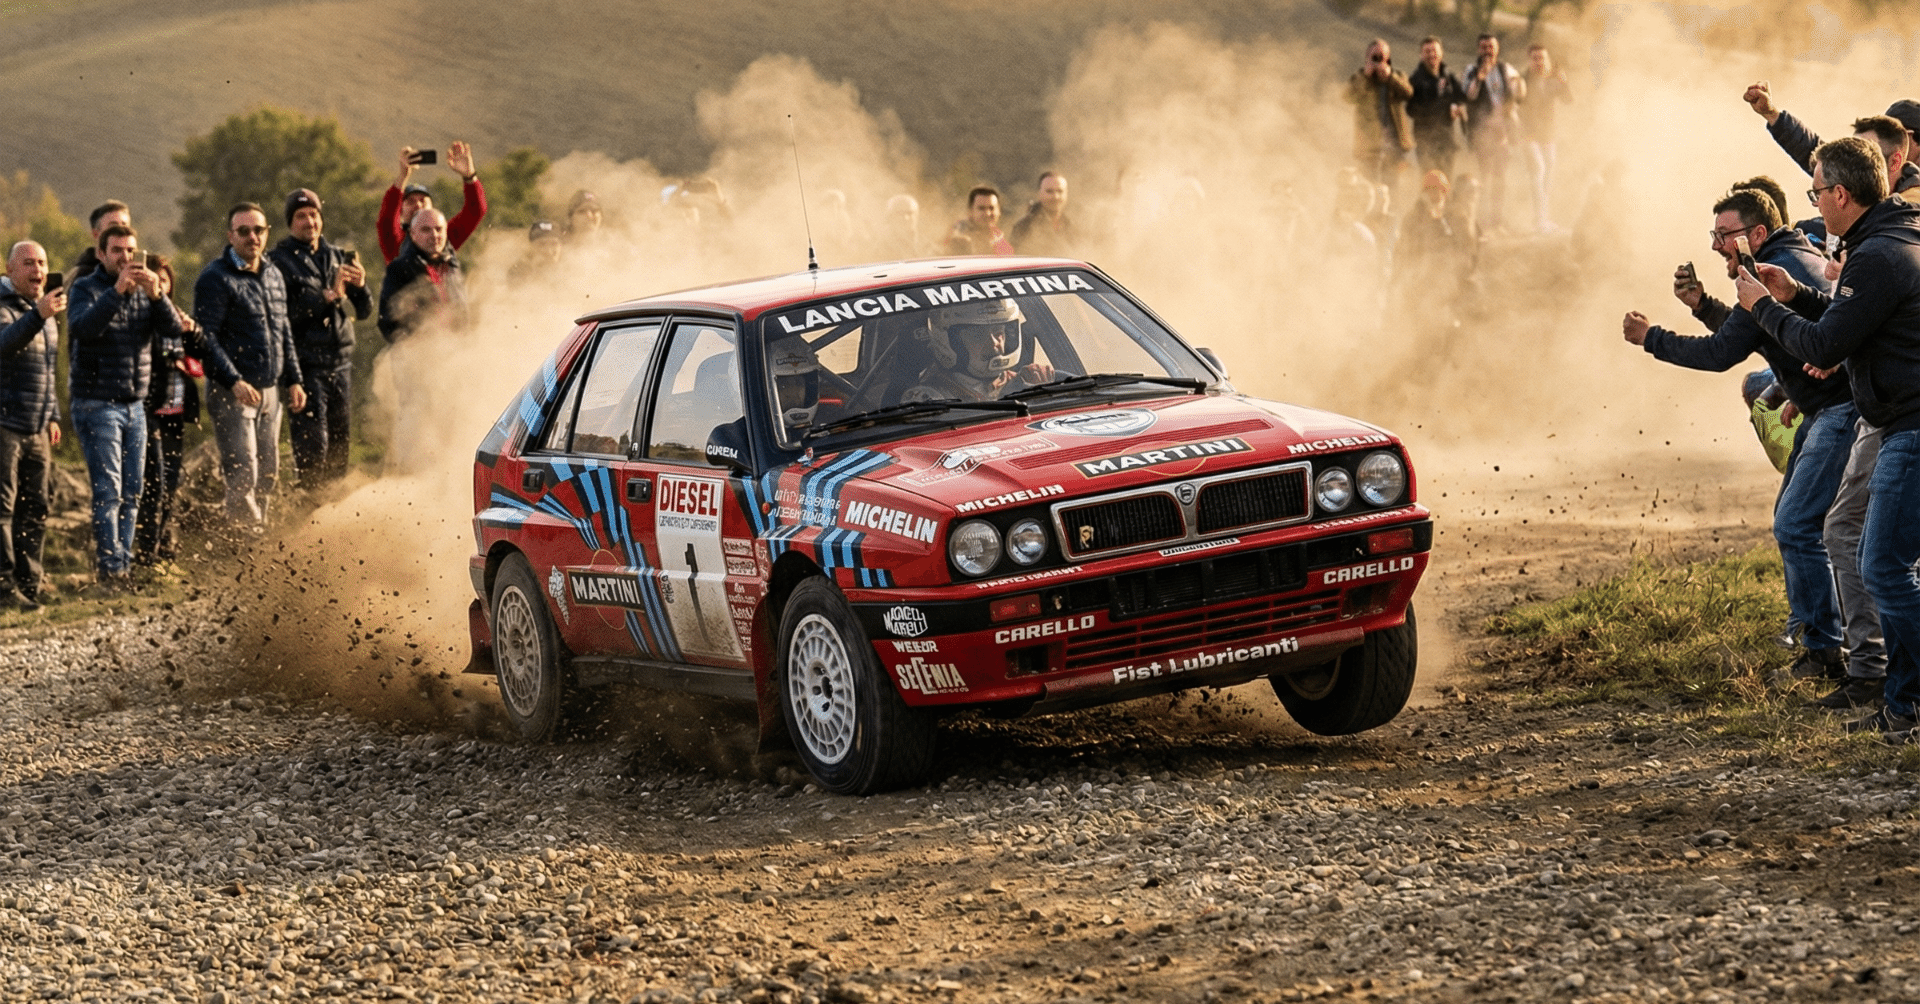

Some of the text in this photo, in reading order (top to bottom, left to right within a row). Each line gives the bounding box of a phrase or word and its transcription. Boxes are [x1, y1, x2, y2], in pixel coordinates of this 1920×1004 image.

[778, 274, 1094, 333] LANCIA MARTINA
[1084, 438, 1245, 476] MARTINI
[1286, 434, 1389, 454] MICHELIN
[659, 479, 718, 516] DIESEL
[955, 484, 1065, 513] MICHELIN
[844, 500, 938, 544] MICHELIN
[1323, 556, 1414, 585] CARELLO
[571, 576, 641, 605] MARTINI
[995, 615, 1095, 644] CARELLO
[1112, 637, 1299, 685] Fist Lubricanti
